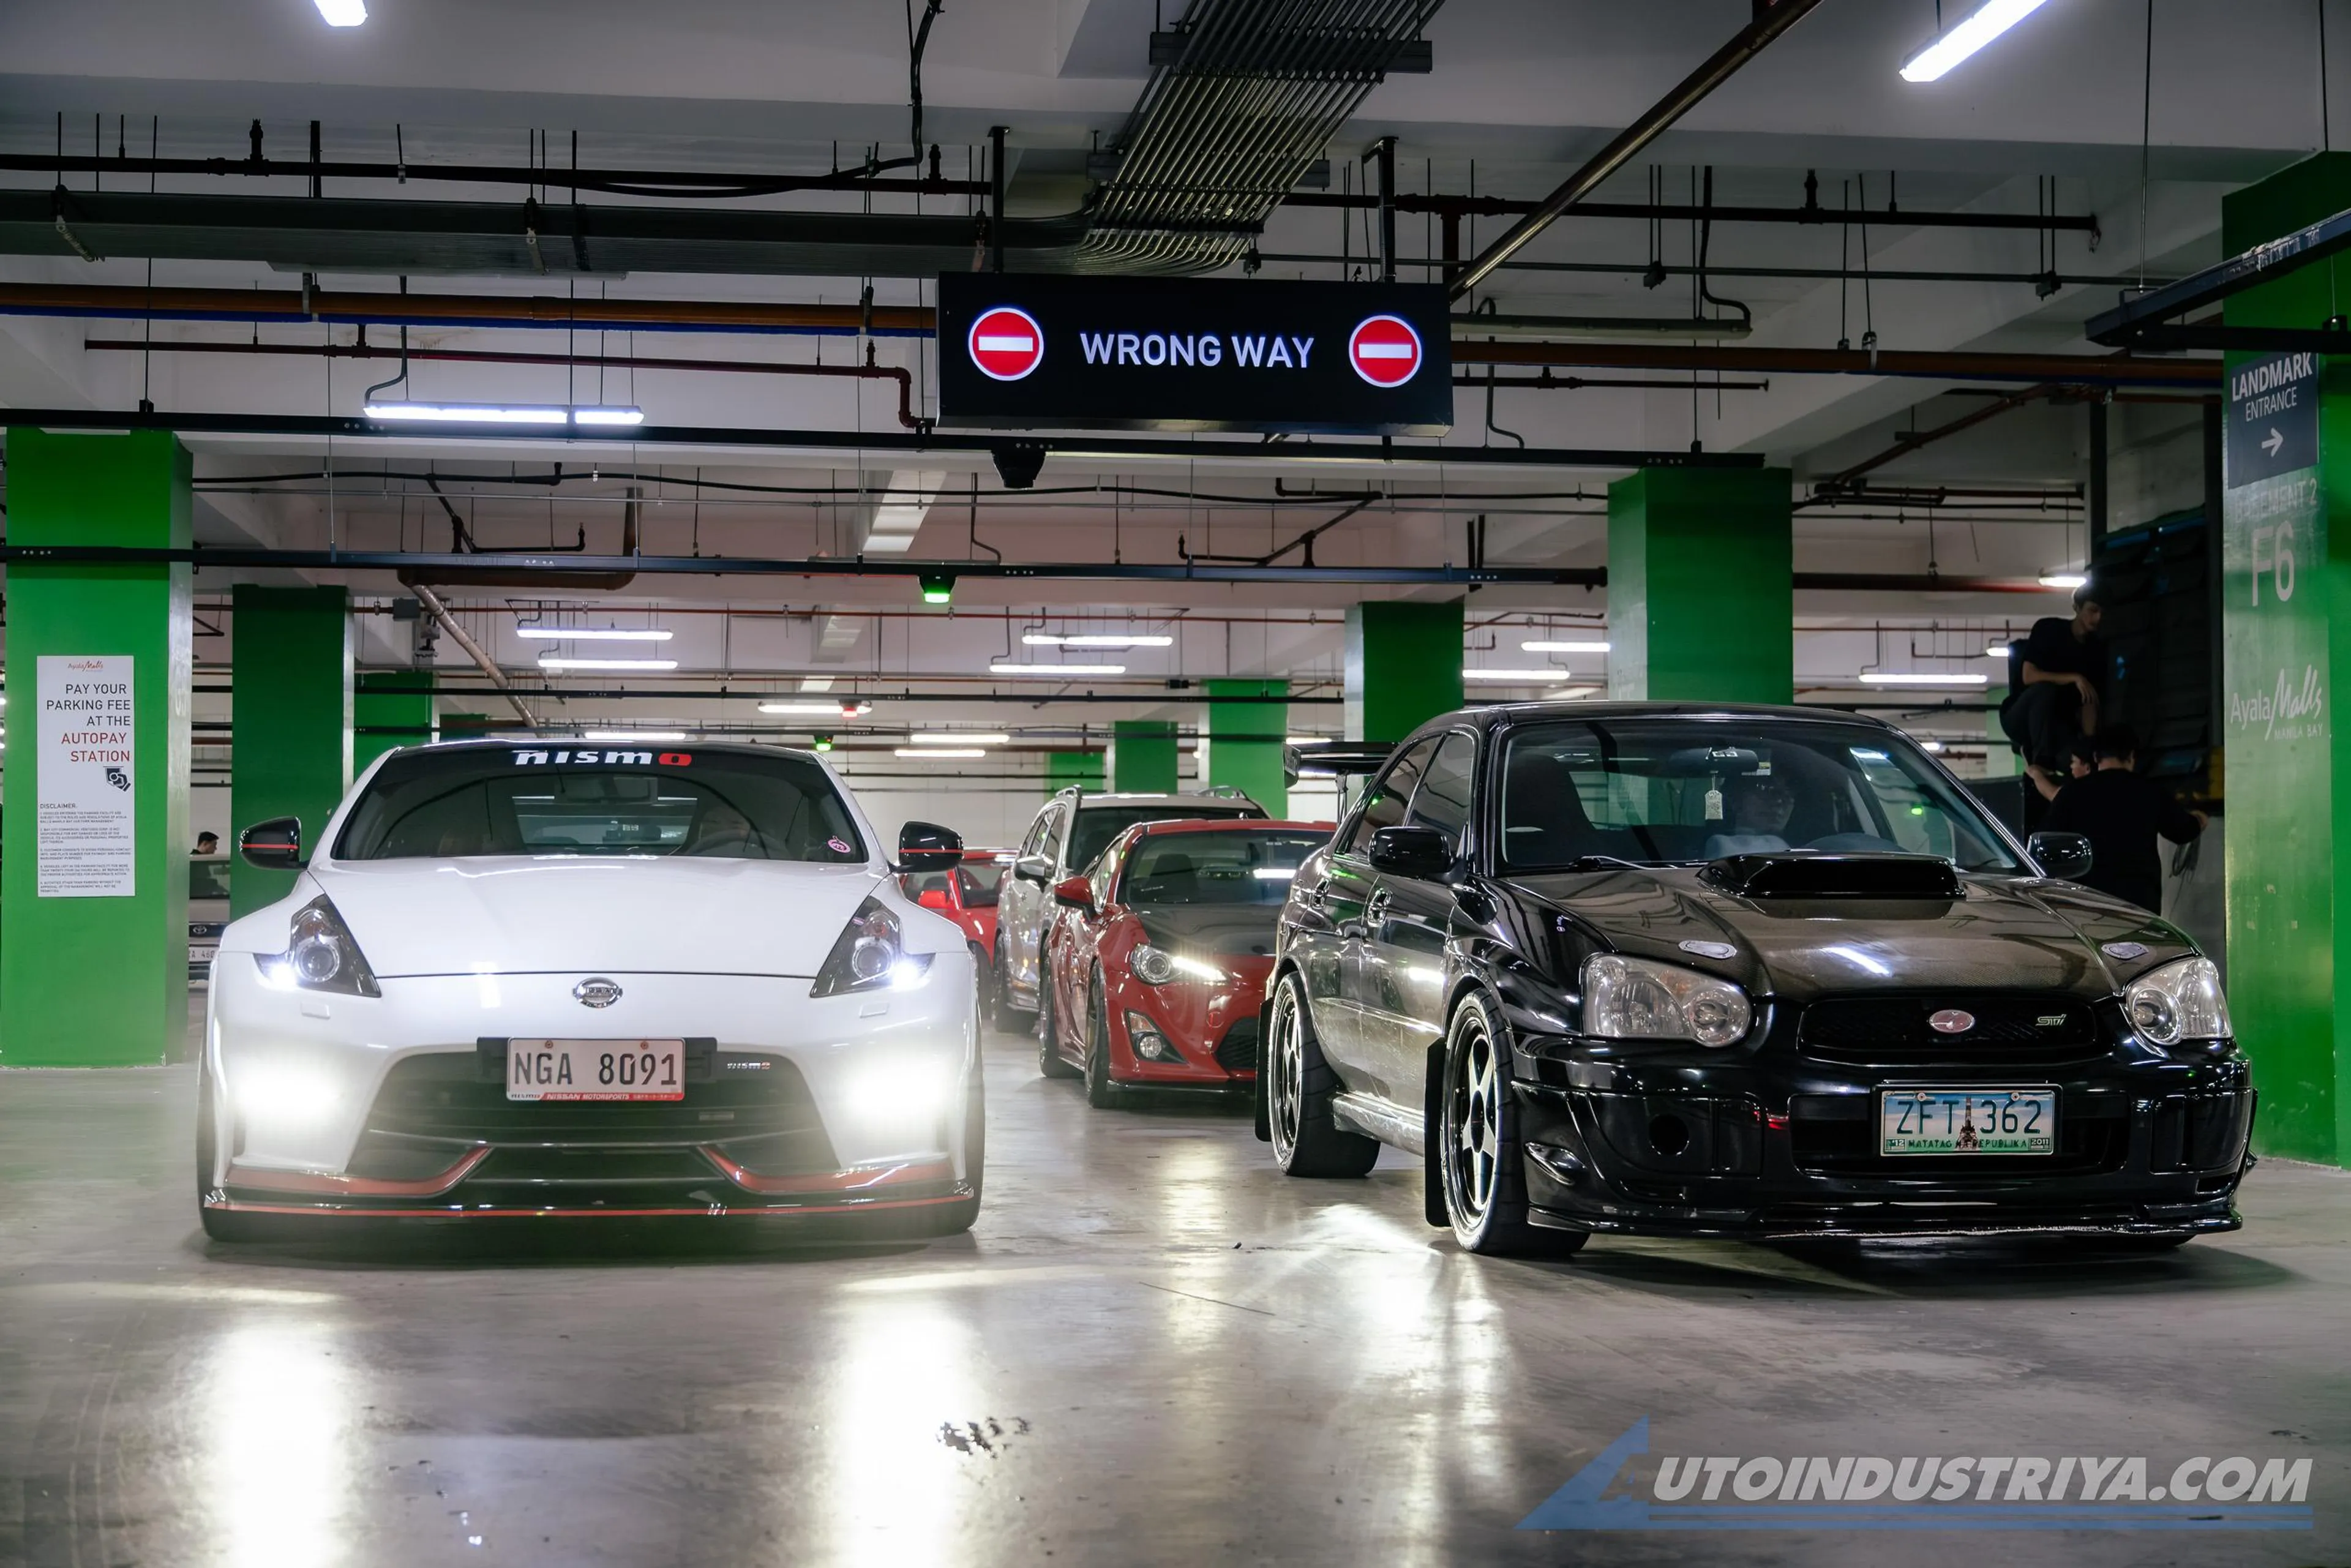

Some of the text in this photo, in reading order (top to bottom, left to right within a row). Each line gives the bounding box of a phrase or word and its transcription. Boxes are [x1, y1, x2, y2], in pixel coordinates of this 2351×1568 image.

[1079, 332, 1314, 369] WRONG WAY
[2232, 352, 2312, 402] LANDMARK
[2245, 387, 2297, 422] ENTRANCE
[2309, 478, 2317, 506] 2
[2252, 520, 2294, 607] F6
[66, 684, 127, 694] PAY YOUR
[2230, 664, 2322, 741] Ayala Malls
[47, 700, 130, 710] PARKING FEE
[86, 716, 130, 726] AT THE
[2307, 723, 2323, 737] BAY
[61, 732, 127, 744] AUTOPAY
[70, 751, 130, 762] STATION
[515, 1052, 677, 1086] NGA 8091
[1896, 1100, 2042, 1135] ZFT 362
[1908, 1139, 1952, 1149] MATATAG
[1972, 1138, 2027, 1149] REPUBLIKA
